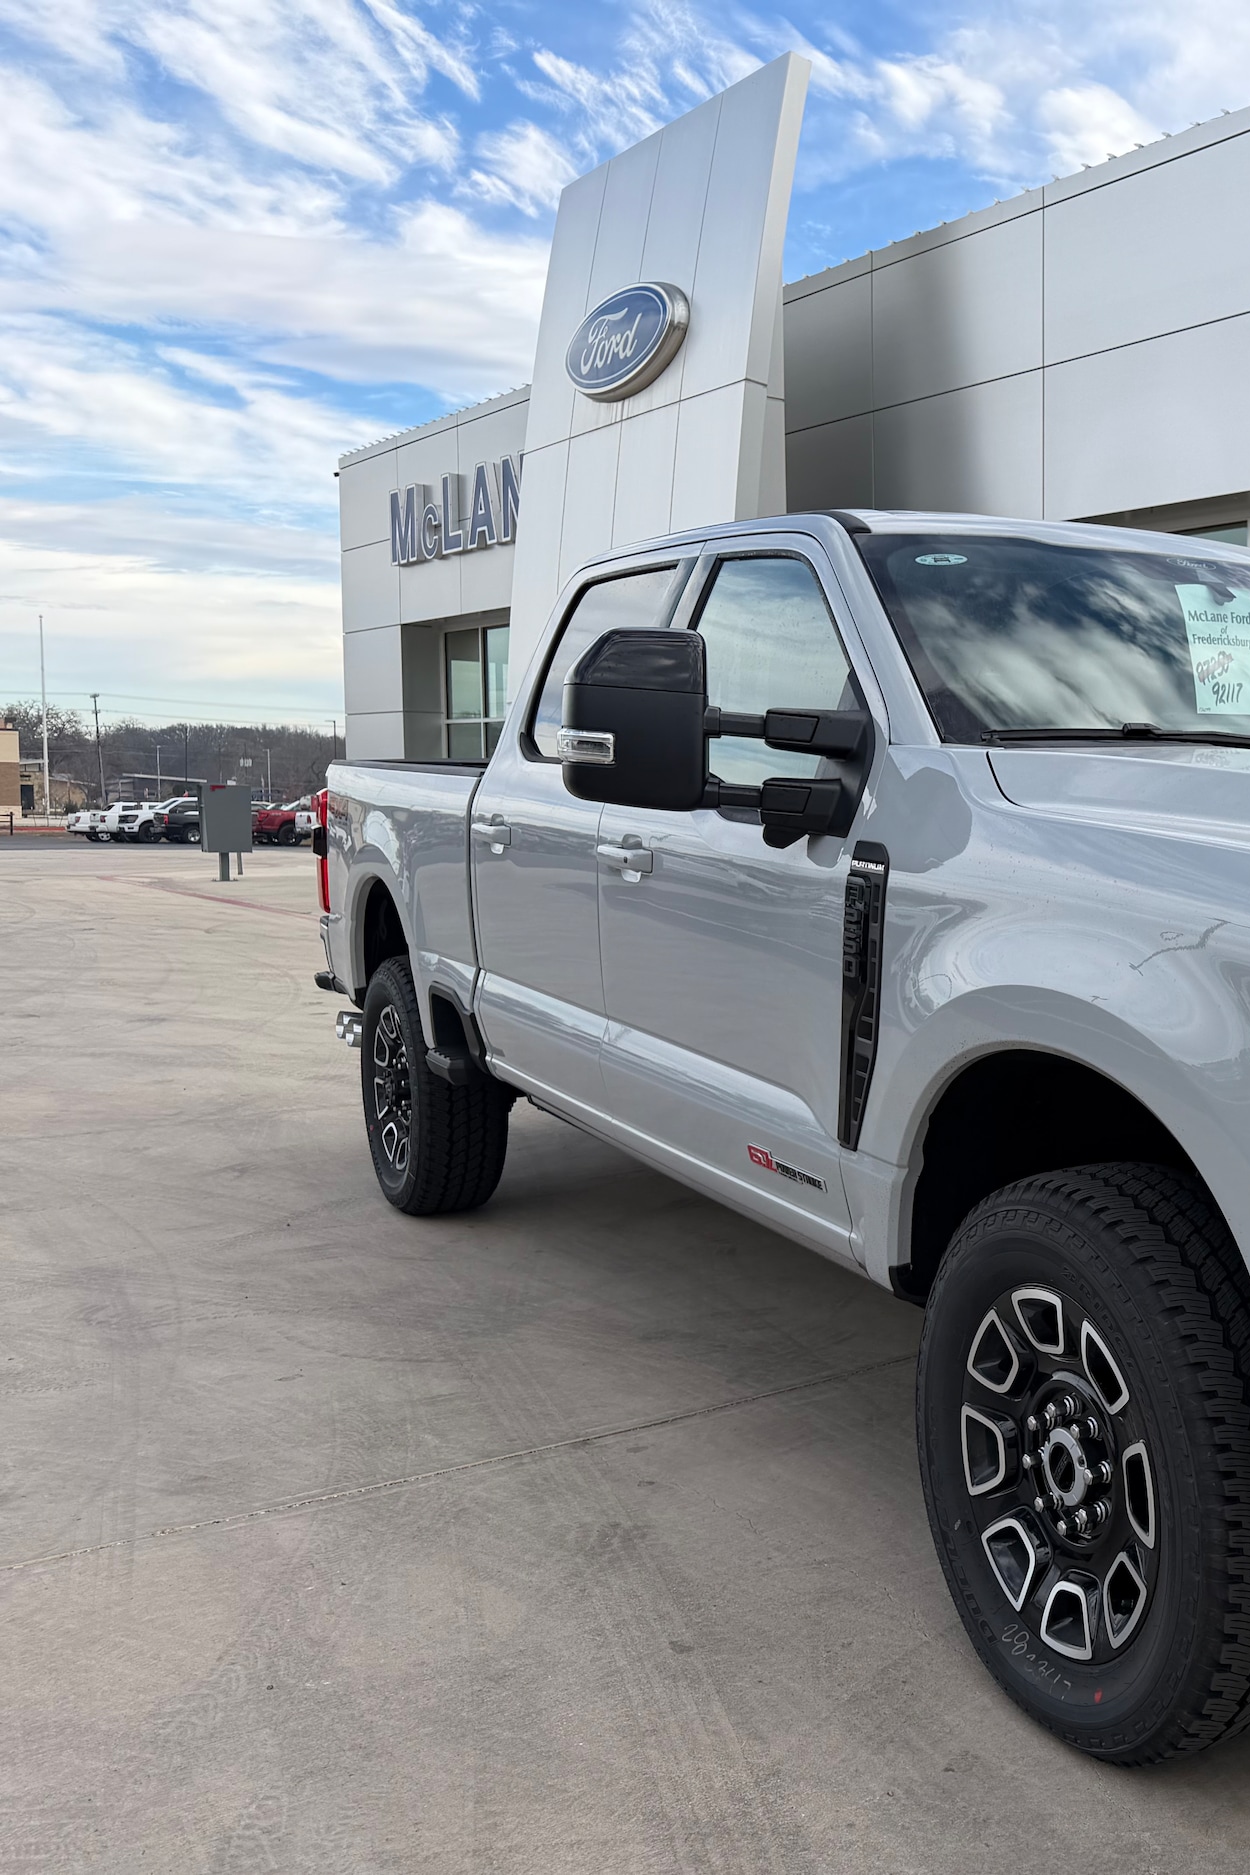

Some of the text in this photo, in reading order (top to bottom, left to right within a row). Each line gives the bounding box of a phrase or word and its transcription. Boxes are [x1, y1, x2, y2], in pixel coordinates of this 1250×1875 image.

[580, 307, 643, 376] Ford
[1188, 609, 1228, 623] McLane
[1220, 626, 1228, 635] of
[1211, 681, 1243, 707] 92117
[851, 859, 885, 871] PLATINUM
